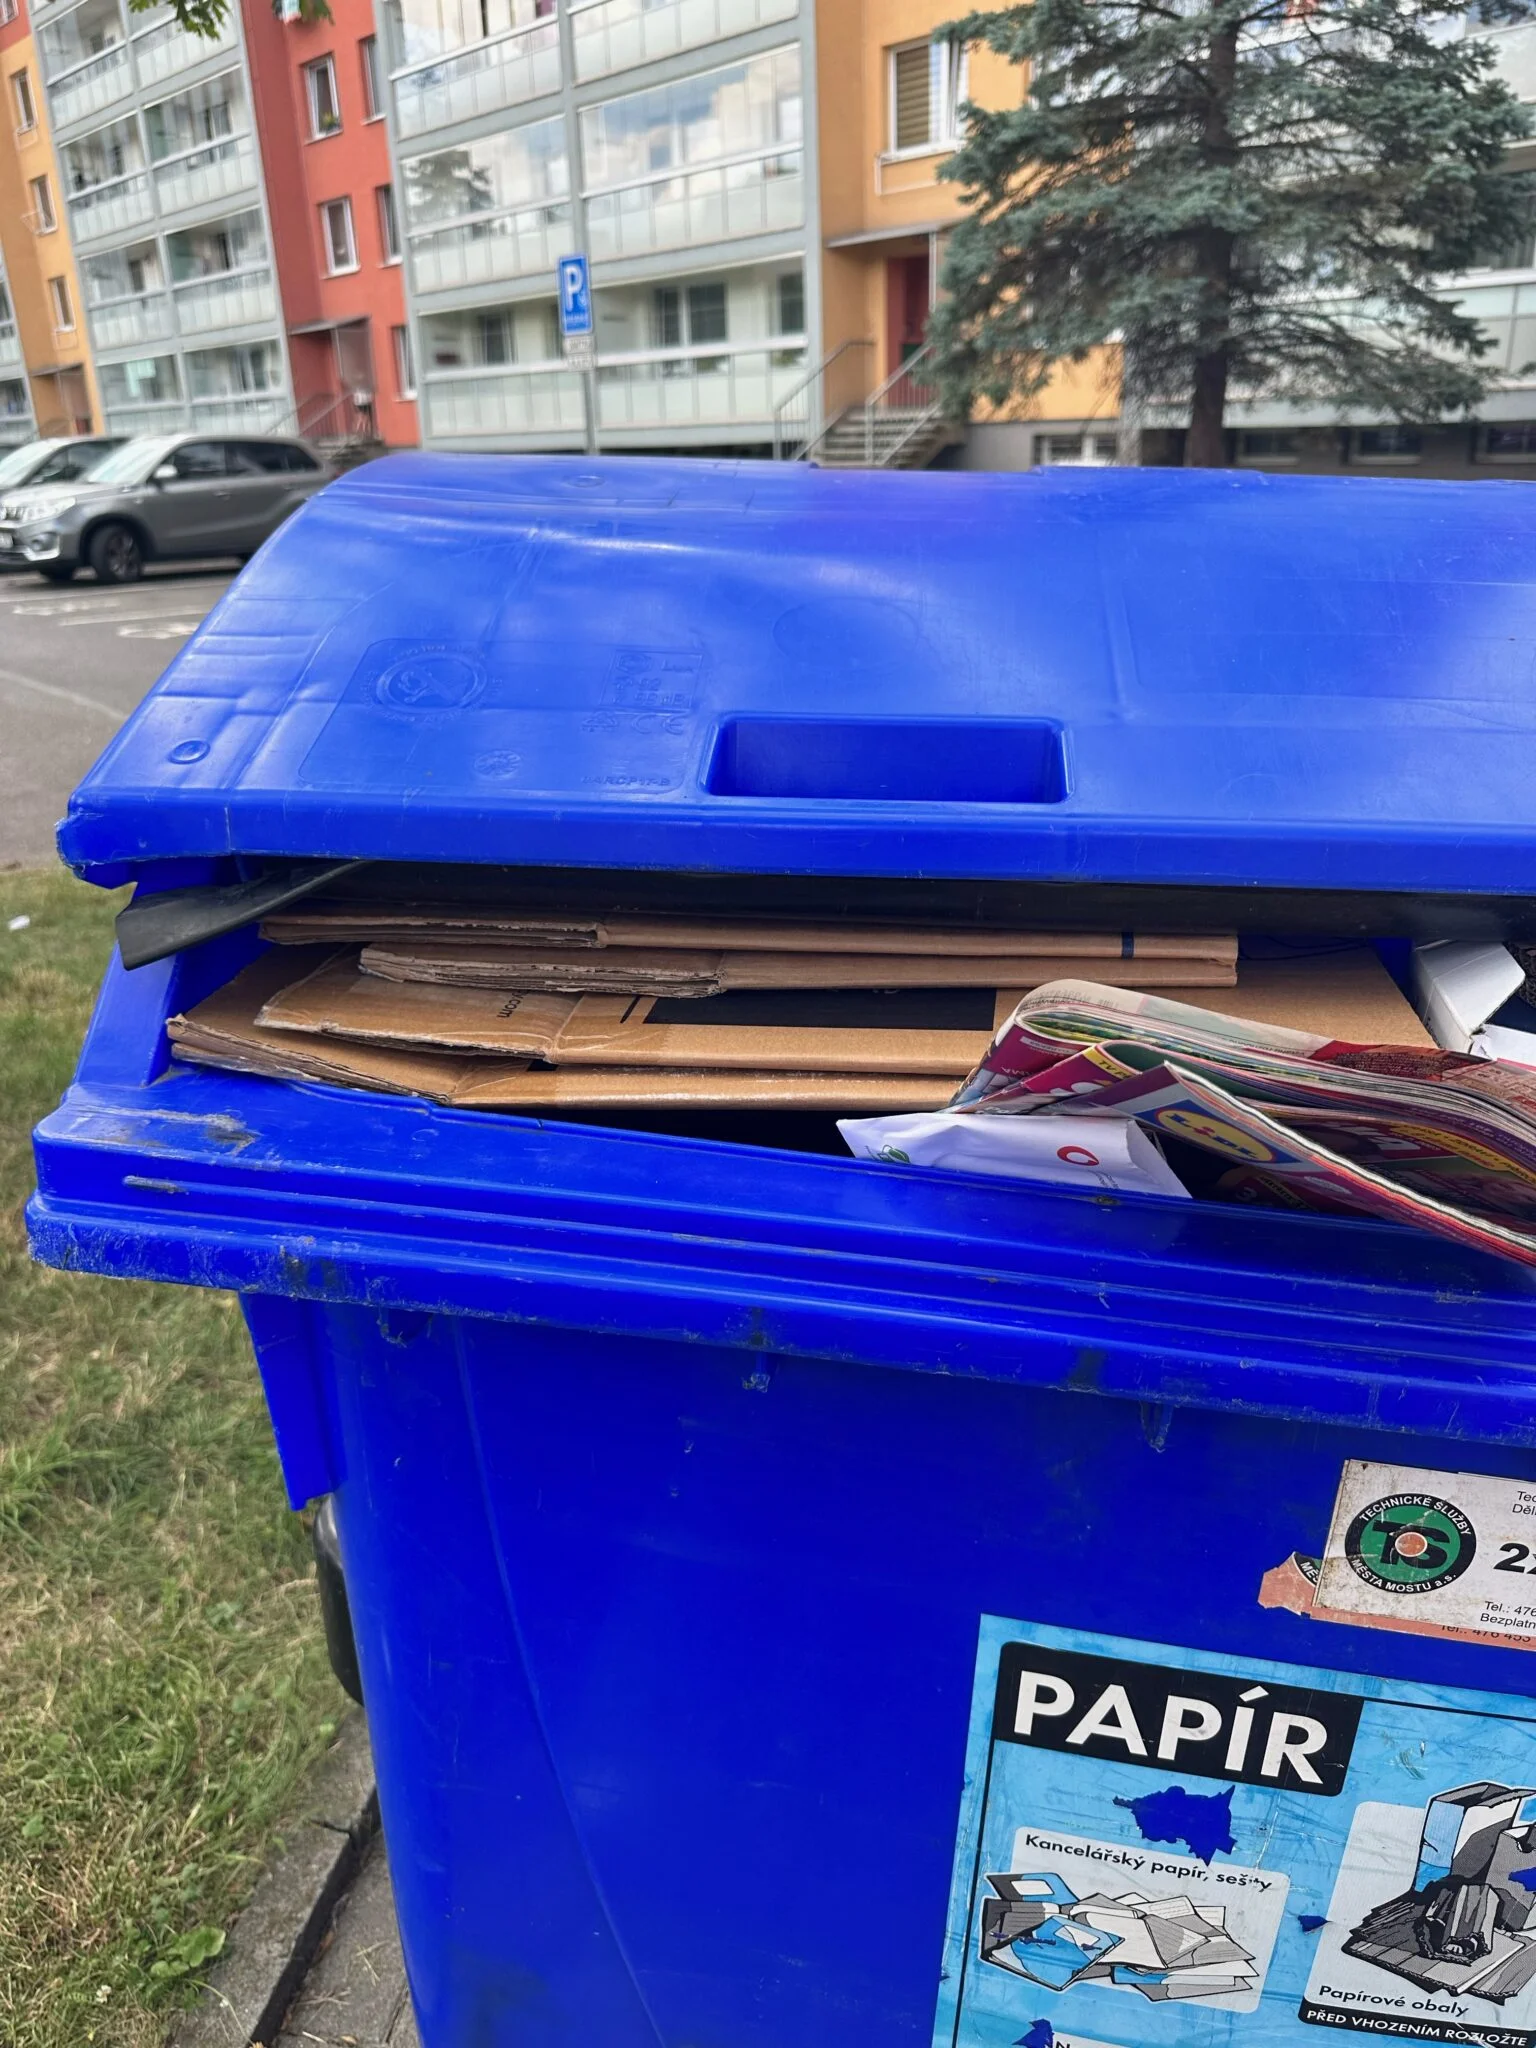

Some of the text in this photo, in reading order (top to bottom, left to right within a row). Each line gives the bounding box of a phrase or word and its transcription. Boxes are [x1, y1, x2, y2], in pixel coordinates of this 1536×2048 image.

[564, 264, 583, 312] P
[1359, 1495, 1433, 1524] TECHNICKÉ
[1371, 1519, 1451, 1570] TS
[1351, 1558, 1457, 1593] MĚSTA MOSTU a.s.
[1485, 1600, 1510, 1614] Tel.:
[1013, 1669, 1328, 1785] PAPÍR
[1024, 1833, 1147, 1871] Kancelářský
[1150, 1859, 1209, 1882] papír,
[1318, 1984, 1470, 2018] Papírové obaly
[1306, 2009, 1528, 2046] PŘED VHOZENÍM ROZLOŽTE
